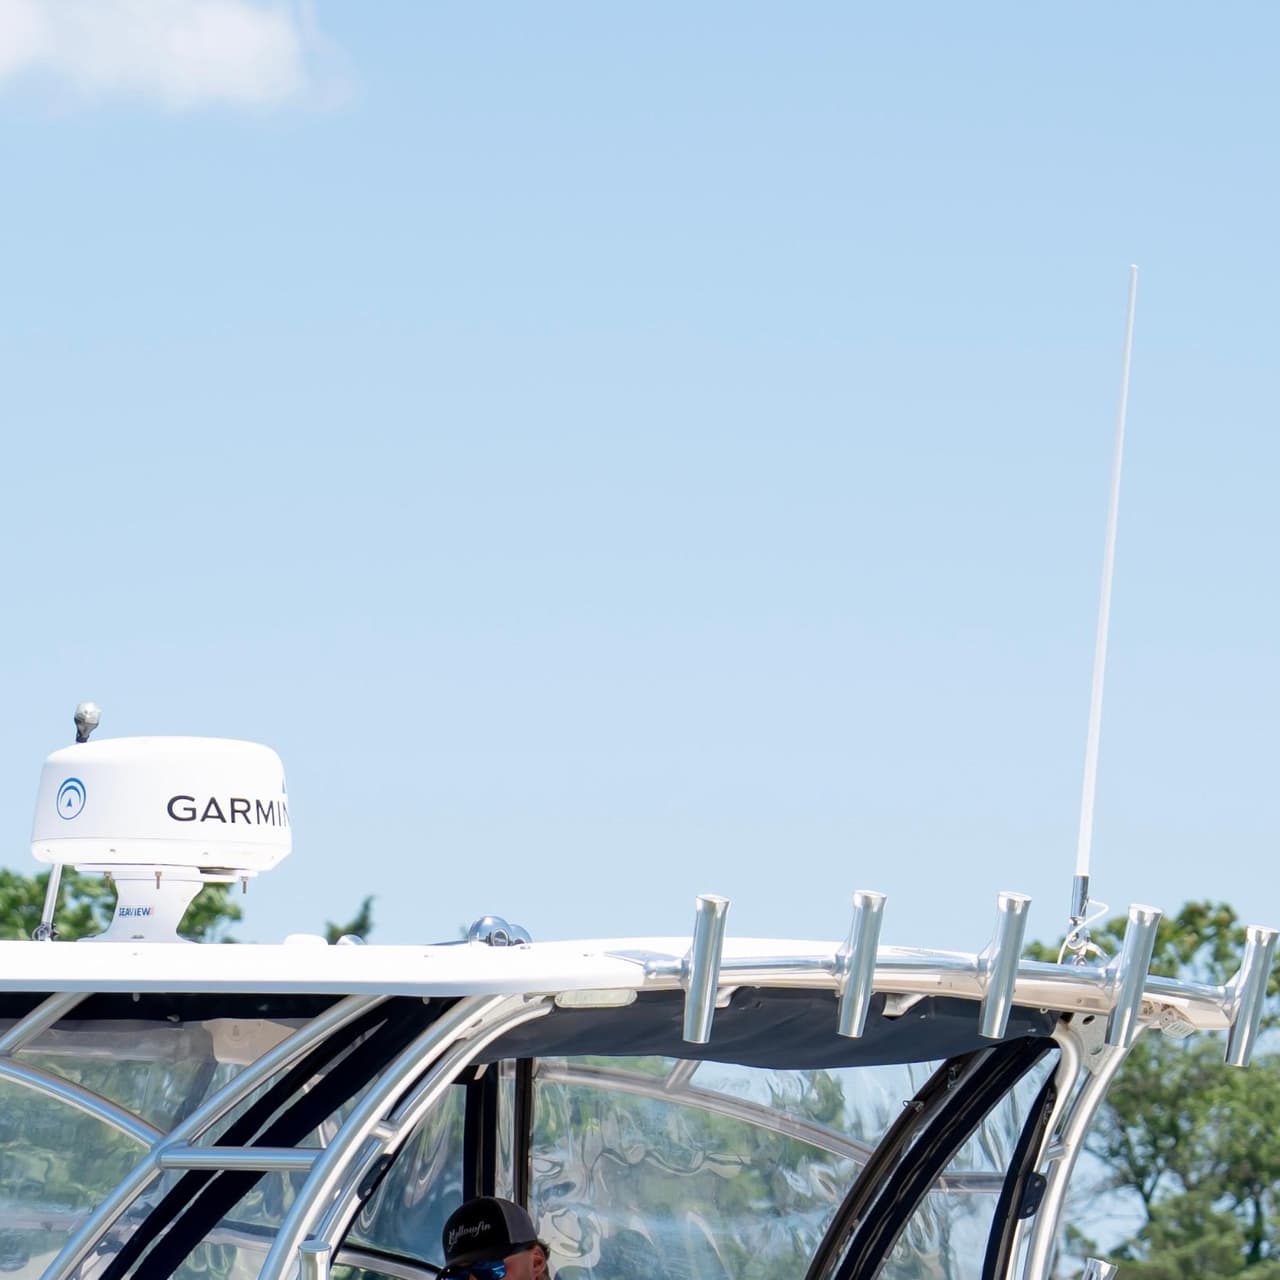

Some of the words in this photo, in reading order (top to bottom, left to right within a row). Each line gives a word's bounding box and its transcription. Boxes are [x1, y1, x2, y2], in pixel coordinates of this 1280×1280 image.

[167, 795, 289, 827] GARMIN
[119, 907, 151, 917] SEAVIEW
[448, 1221, 491, 1252] Yellowfin
